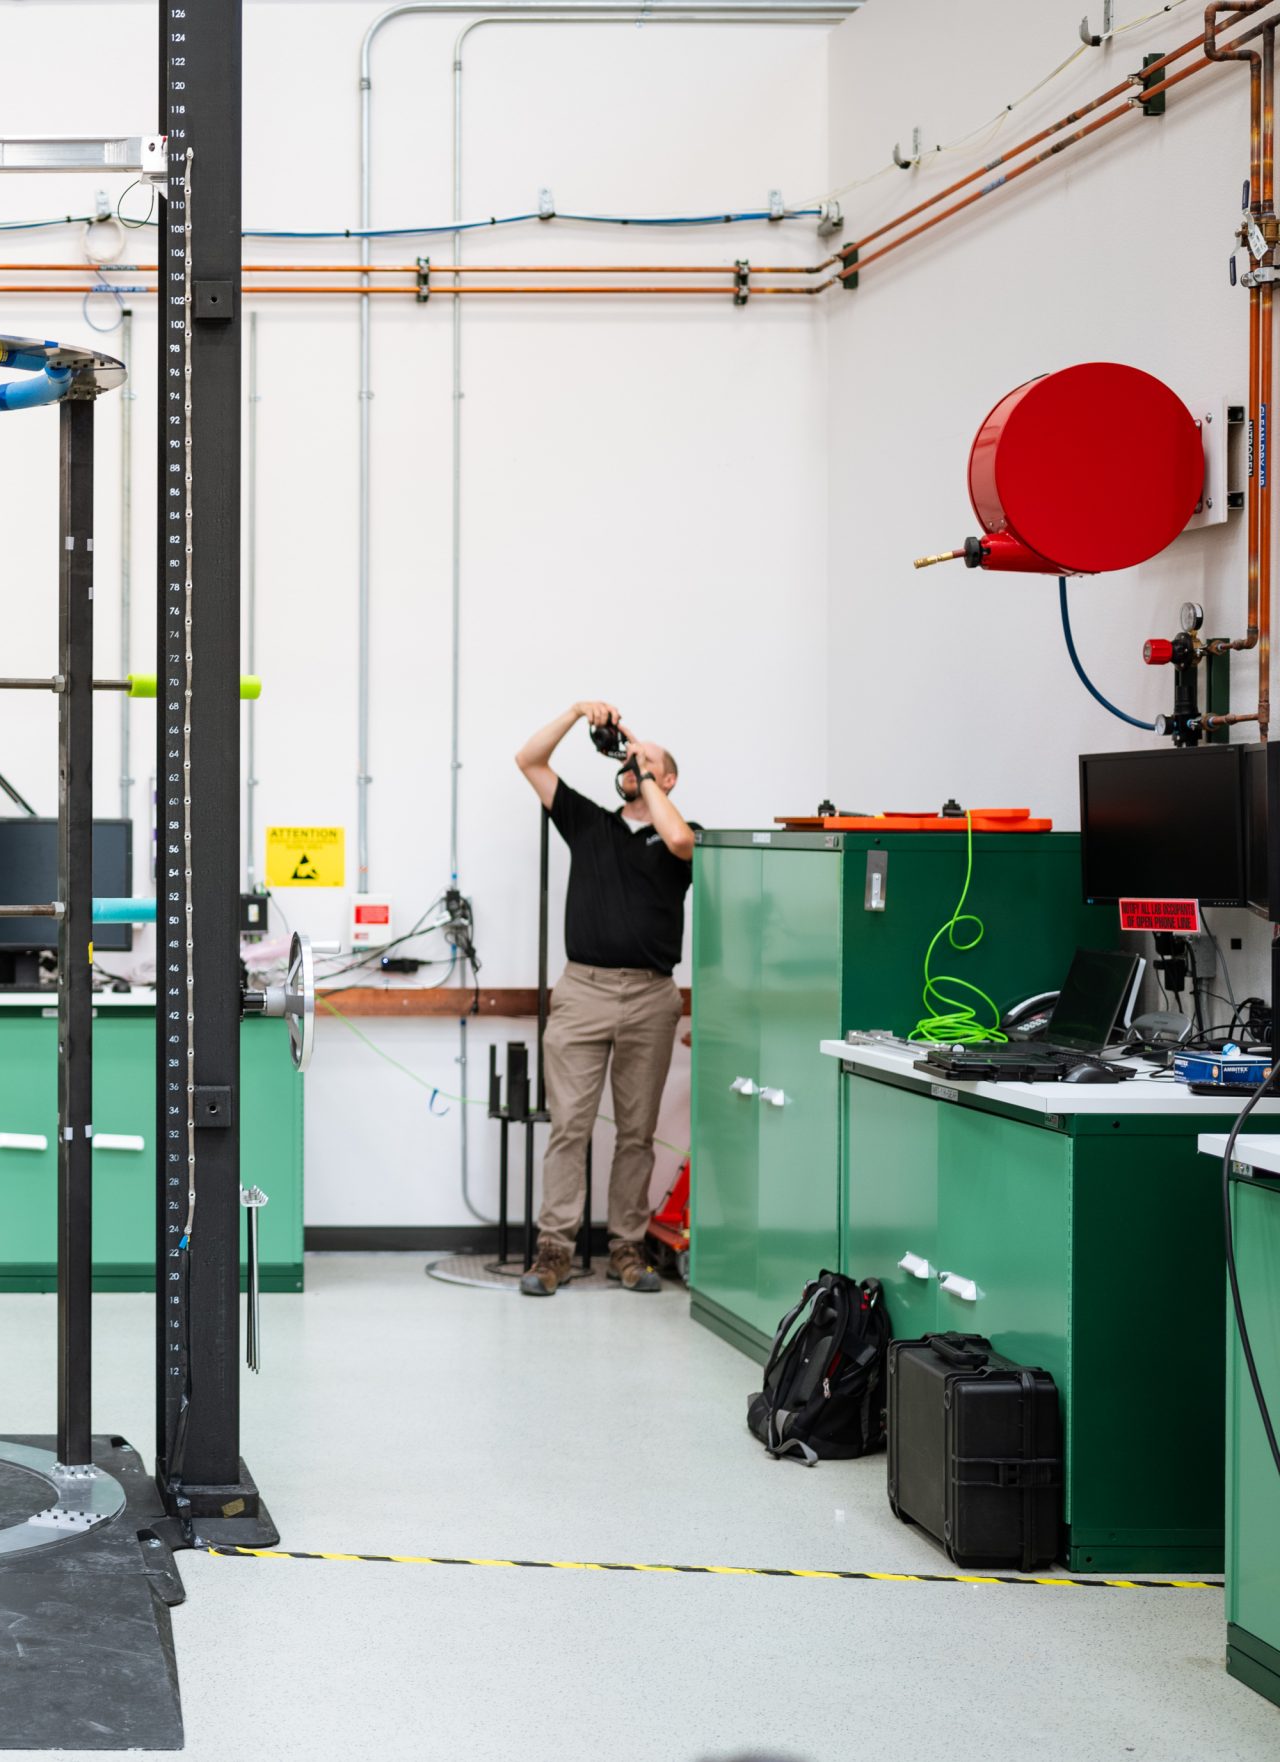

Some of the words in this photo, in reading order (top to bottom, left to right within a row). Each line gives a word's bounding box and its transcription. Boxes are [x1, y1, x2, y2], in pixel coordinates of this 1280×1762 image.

[171, 9, 185, 19] 126
[171, 33, 185, 42] 124
[171, 57, 185, 66] 122
[171, 81, 185, 90] 120
[171, 105, 185, 114] 118
[170, 129, 185, 138] 116
[170, 152, 185, 162] 114
[170, 176, 185, 186] 112
[170, 200, 185, 210] 110
[170, 248, 185, 258] 106
[170, 272, 185, 281] 104
[170, 296, 185, 305] 102
[170, 320, 185, 329] 100
[169, 343, 181, 353] 98
[169, 367, 181, 377] 96
[169, 391, 181, 401] 94
[169, 415, 181, 425] 92
[169, 439, 181, 449] 90
[169, 463, 181, 473] 88
[169, 487, 181, 497] 86
[169, 511, 181, 520] 84
[169, 535, 181, 544] 82
[169, 559, 180, 568] 80
[169, 582, 181, 592] 78
[169, 606, 180, 616] 76
[169, 630, 180, 639] 74
[169, 654, 180, 663] 72
[168, 678, 180, 687] 70
[168, 702, 180, 711] 68
[168, 725, 180, 735] 66
[168, 749, 180, 758] 64
[168, 773, 180, 782] 62
[168, 820, 180, 830] 58
[270, 827, 338, 839] ATTENTION
[168, 844, 180, 854] 56
[168, 868, 180, 878] 54
[168, 891, 180, 902] 52
[168, 915, 180, 925] 50
[168, 939, 180, 949] 48
[168, 963, 180, 972] 46
[168, 987, 180, 996] 44
[168, 1011, 180, 1020] 42
[168, 1035, 180, 1044] 40
[168, 1058, 180, 1068] 38
[168, 1082, 180, 1091] 36
[168, 1106, 180, 1115] 34
[168, 1129, 180, 1139] 32
[168, 1224, 180, 1233] 24
[168, 1272, 180, 1281] 20
[170, 1296, 180, 1305] 18
[169, 1319, 180, 1329] 16
[170, 1343, 179, 1352] 14
[169, 1366, 180, 1376] 12
